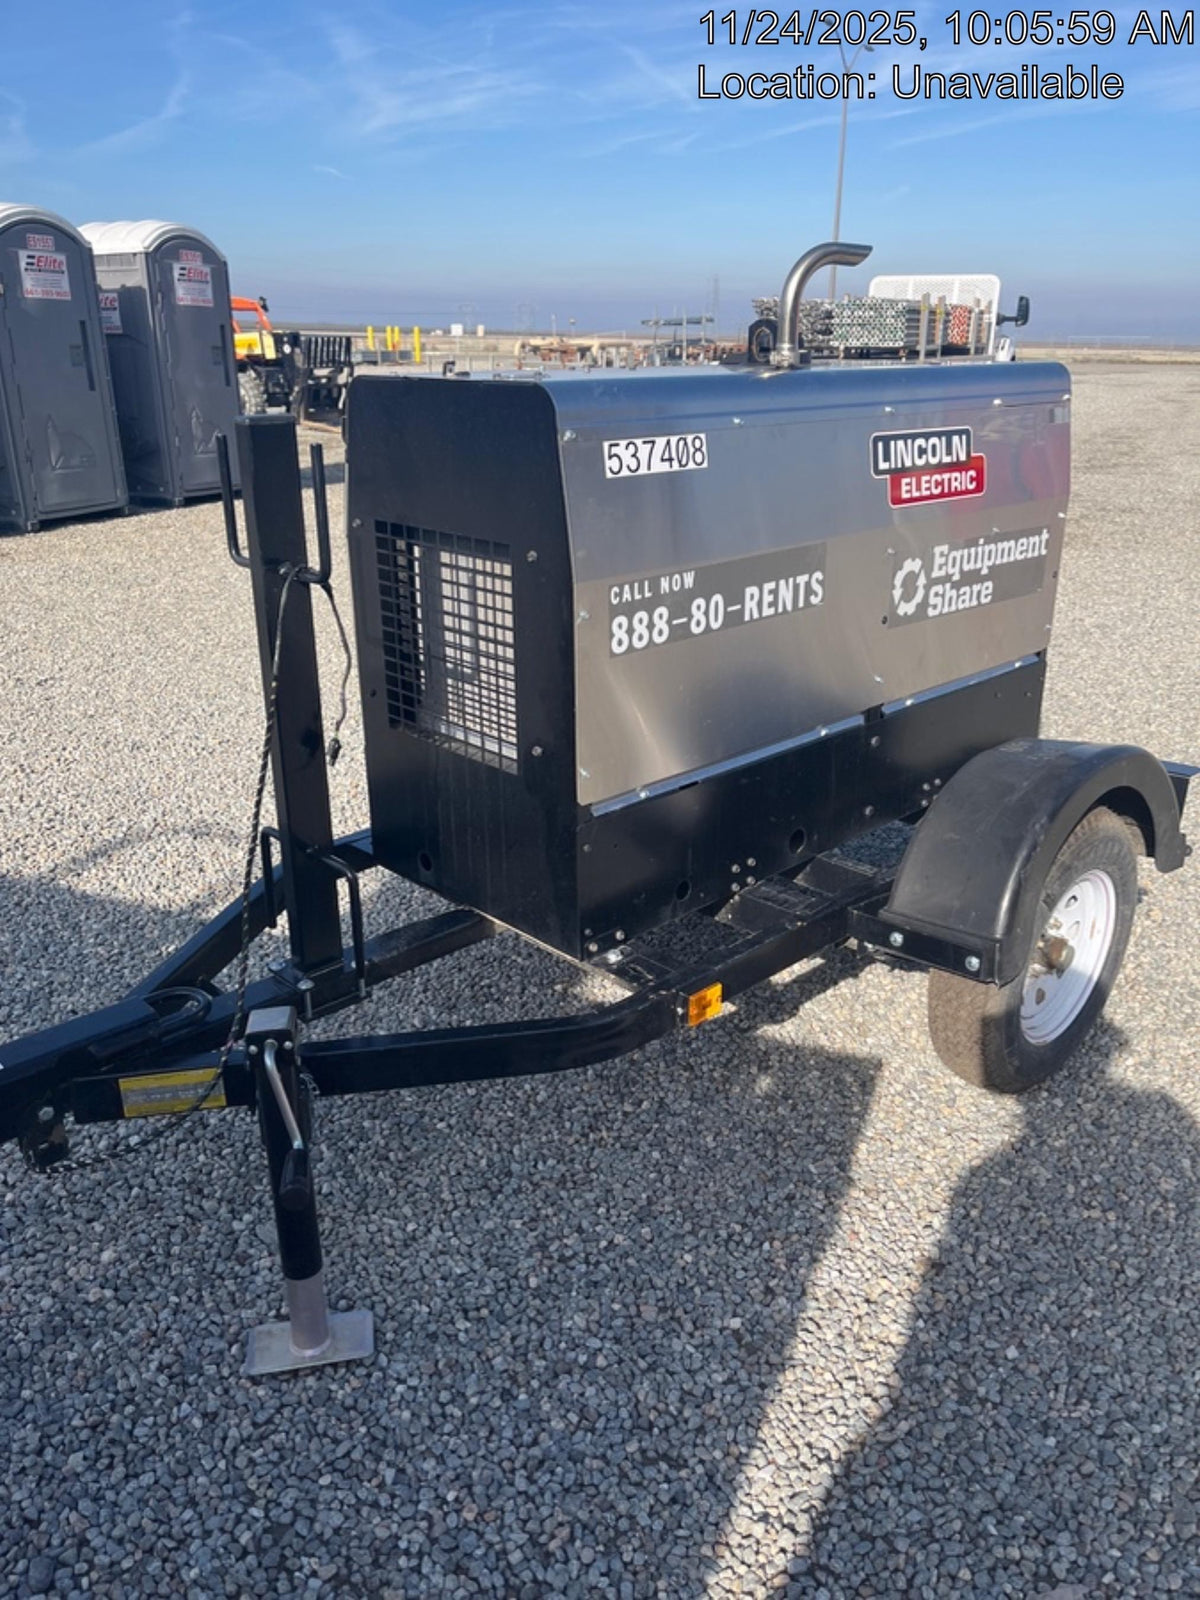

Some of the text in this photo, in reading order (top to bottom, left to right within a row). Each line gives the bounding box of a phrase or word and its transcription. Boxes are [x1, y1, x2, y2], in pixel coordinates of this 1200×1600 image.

[35, 255, 65, 270] Elite
[186, 266, 210, 281] Elite
[608, 435, 705, 475] 537408
[877, 434, 967, 470] LINCOLN
[900, 470, 977, 499] ELECTRIC
[930, 528, 1050, 582] Equipment
[610, 570, 696, 605] CALL NOW
[926, 580, 994, 617] Share
[611, 570, 825, 654] 888-80-RENTS
